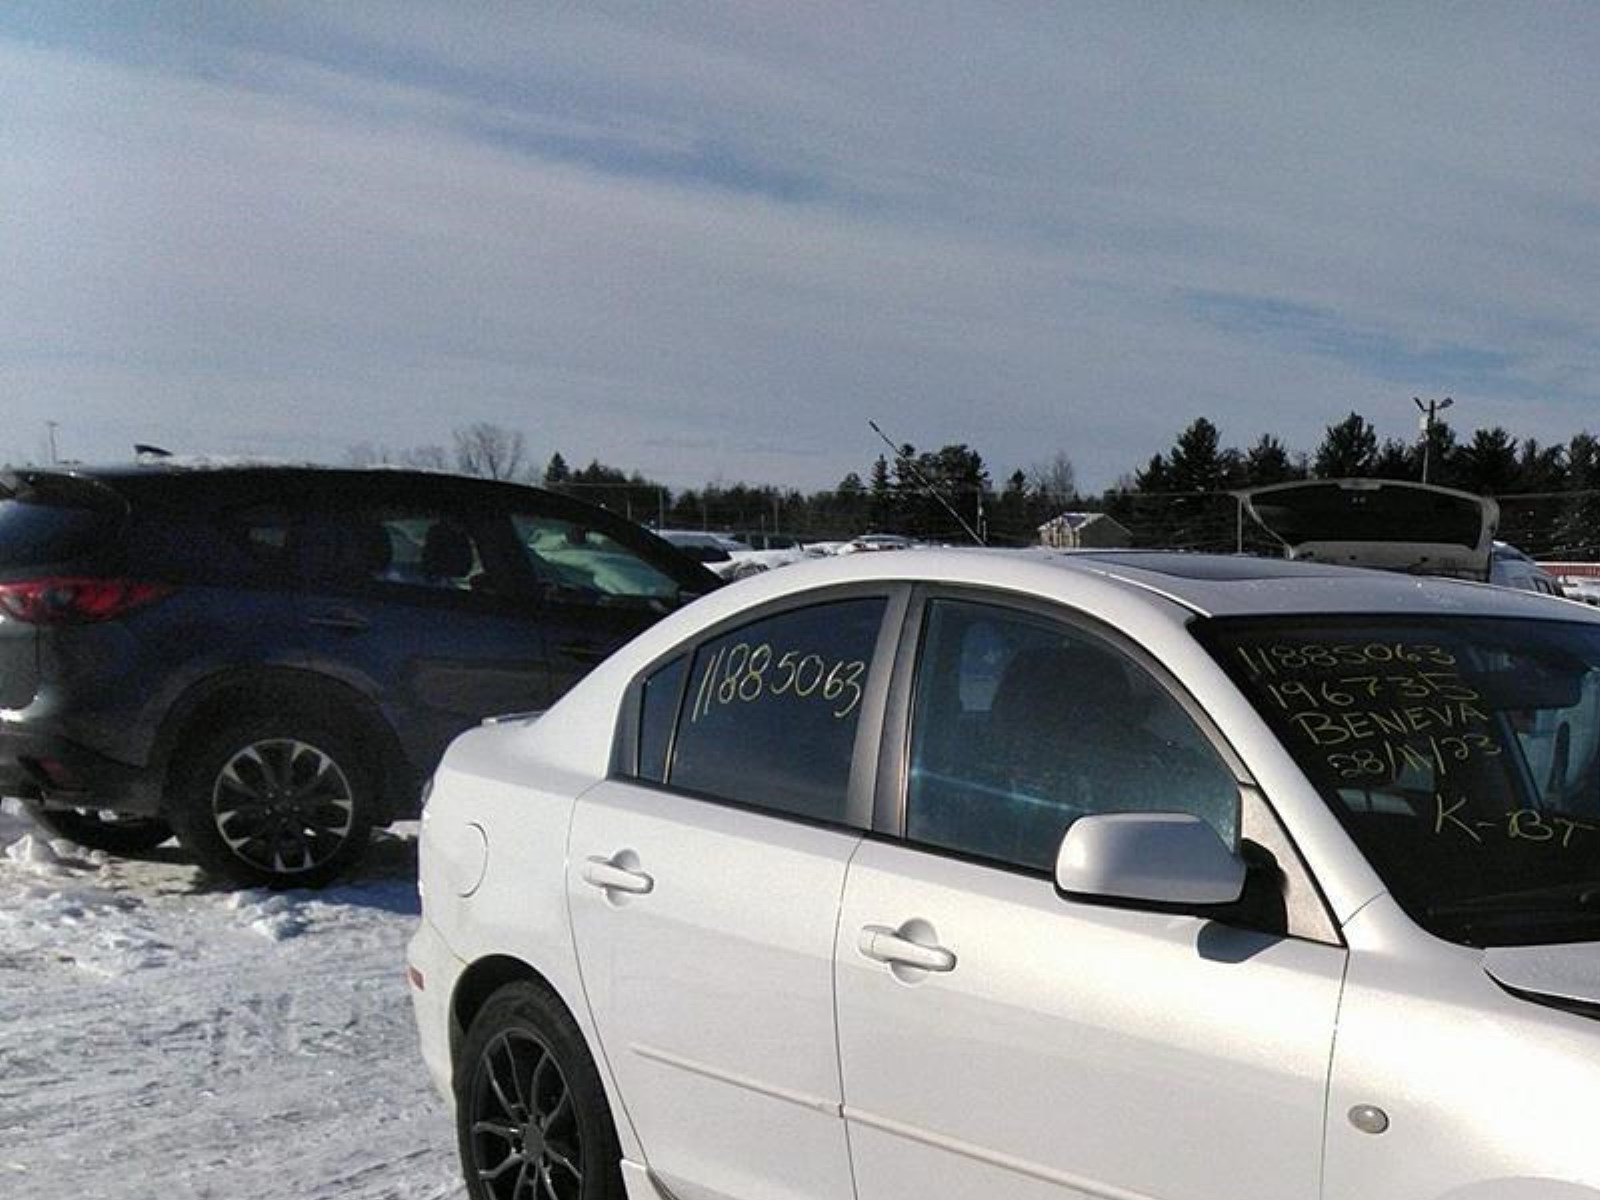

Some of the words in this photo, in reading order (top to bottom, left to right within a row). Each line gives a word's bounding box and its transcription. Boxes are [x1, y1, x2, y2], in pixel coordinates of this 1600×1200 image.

[1238, 642, 1456, 674] 11885063
[691, 643, 865, 721] 11885063
[1268, 672, 1480, 709] 196735
[1293, 702, 1488, 745] BENEVA
